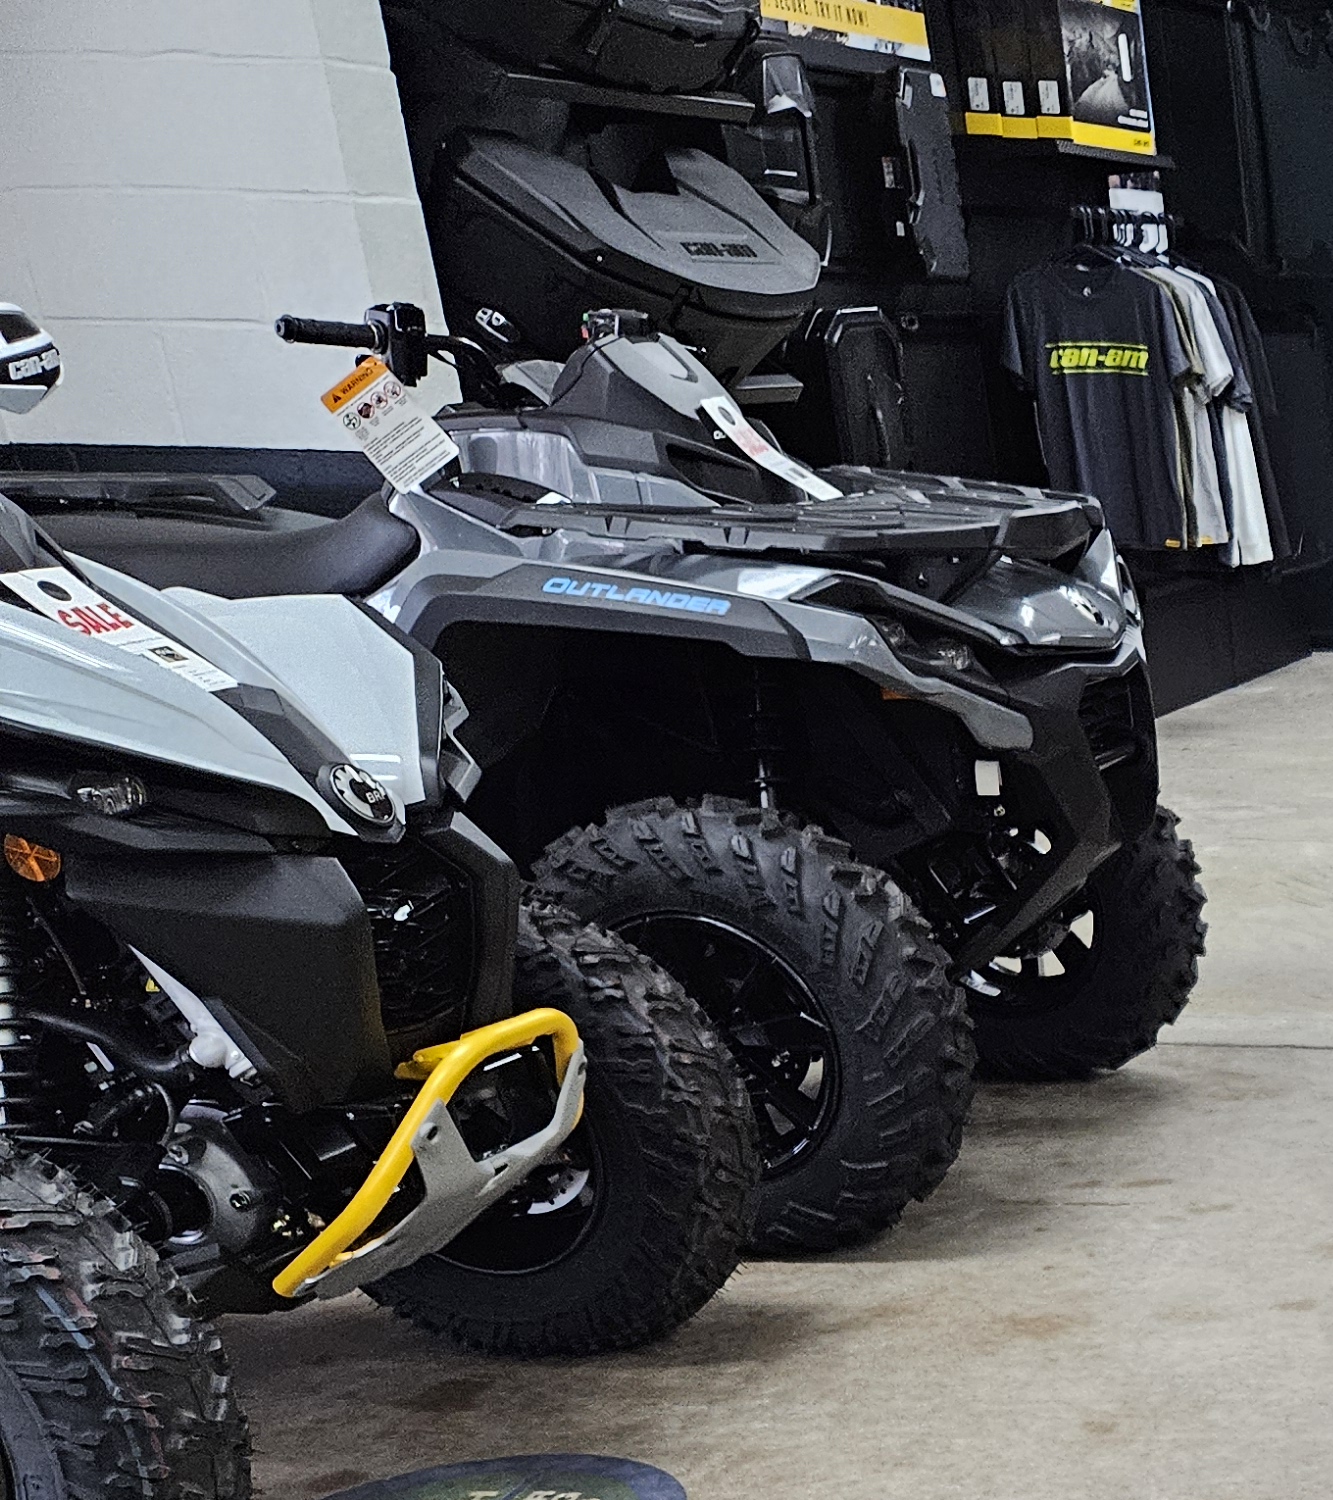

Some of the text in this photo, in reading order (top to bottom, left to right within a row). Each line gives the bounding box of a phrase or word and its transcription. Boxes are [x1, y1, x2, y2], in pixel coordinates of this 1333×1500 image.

[1050, 347, 1149, 369] can-am
[340, 366, 374, 395] WARNING
[542, 576, 732, 617] OUTLANDER
[58, 602, 135, 636] SALE
